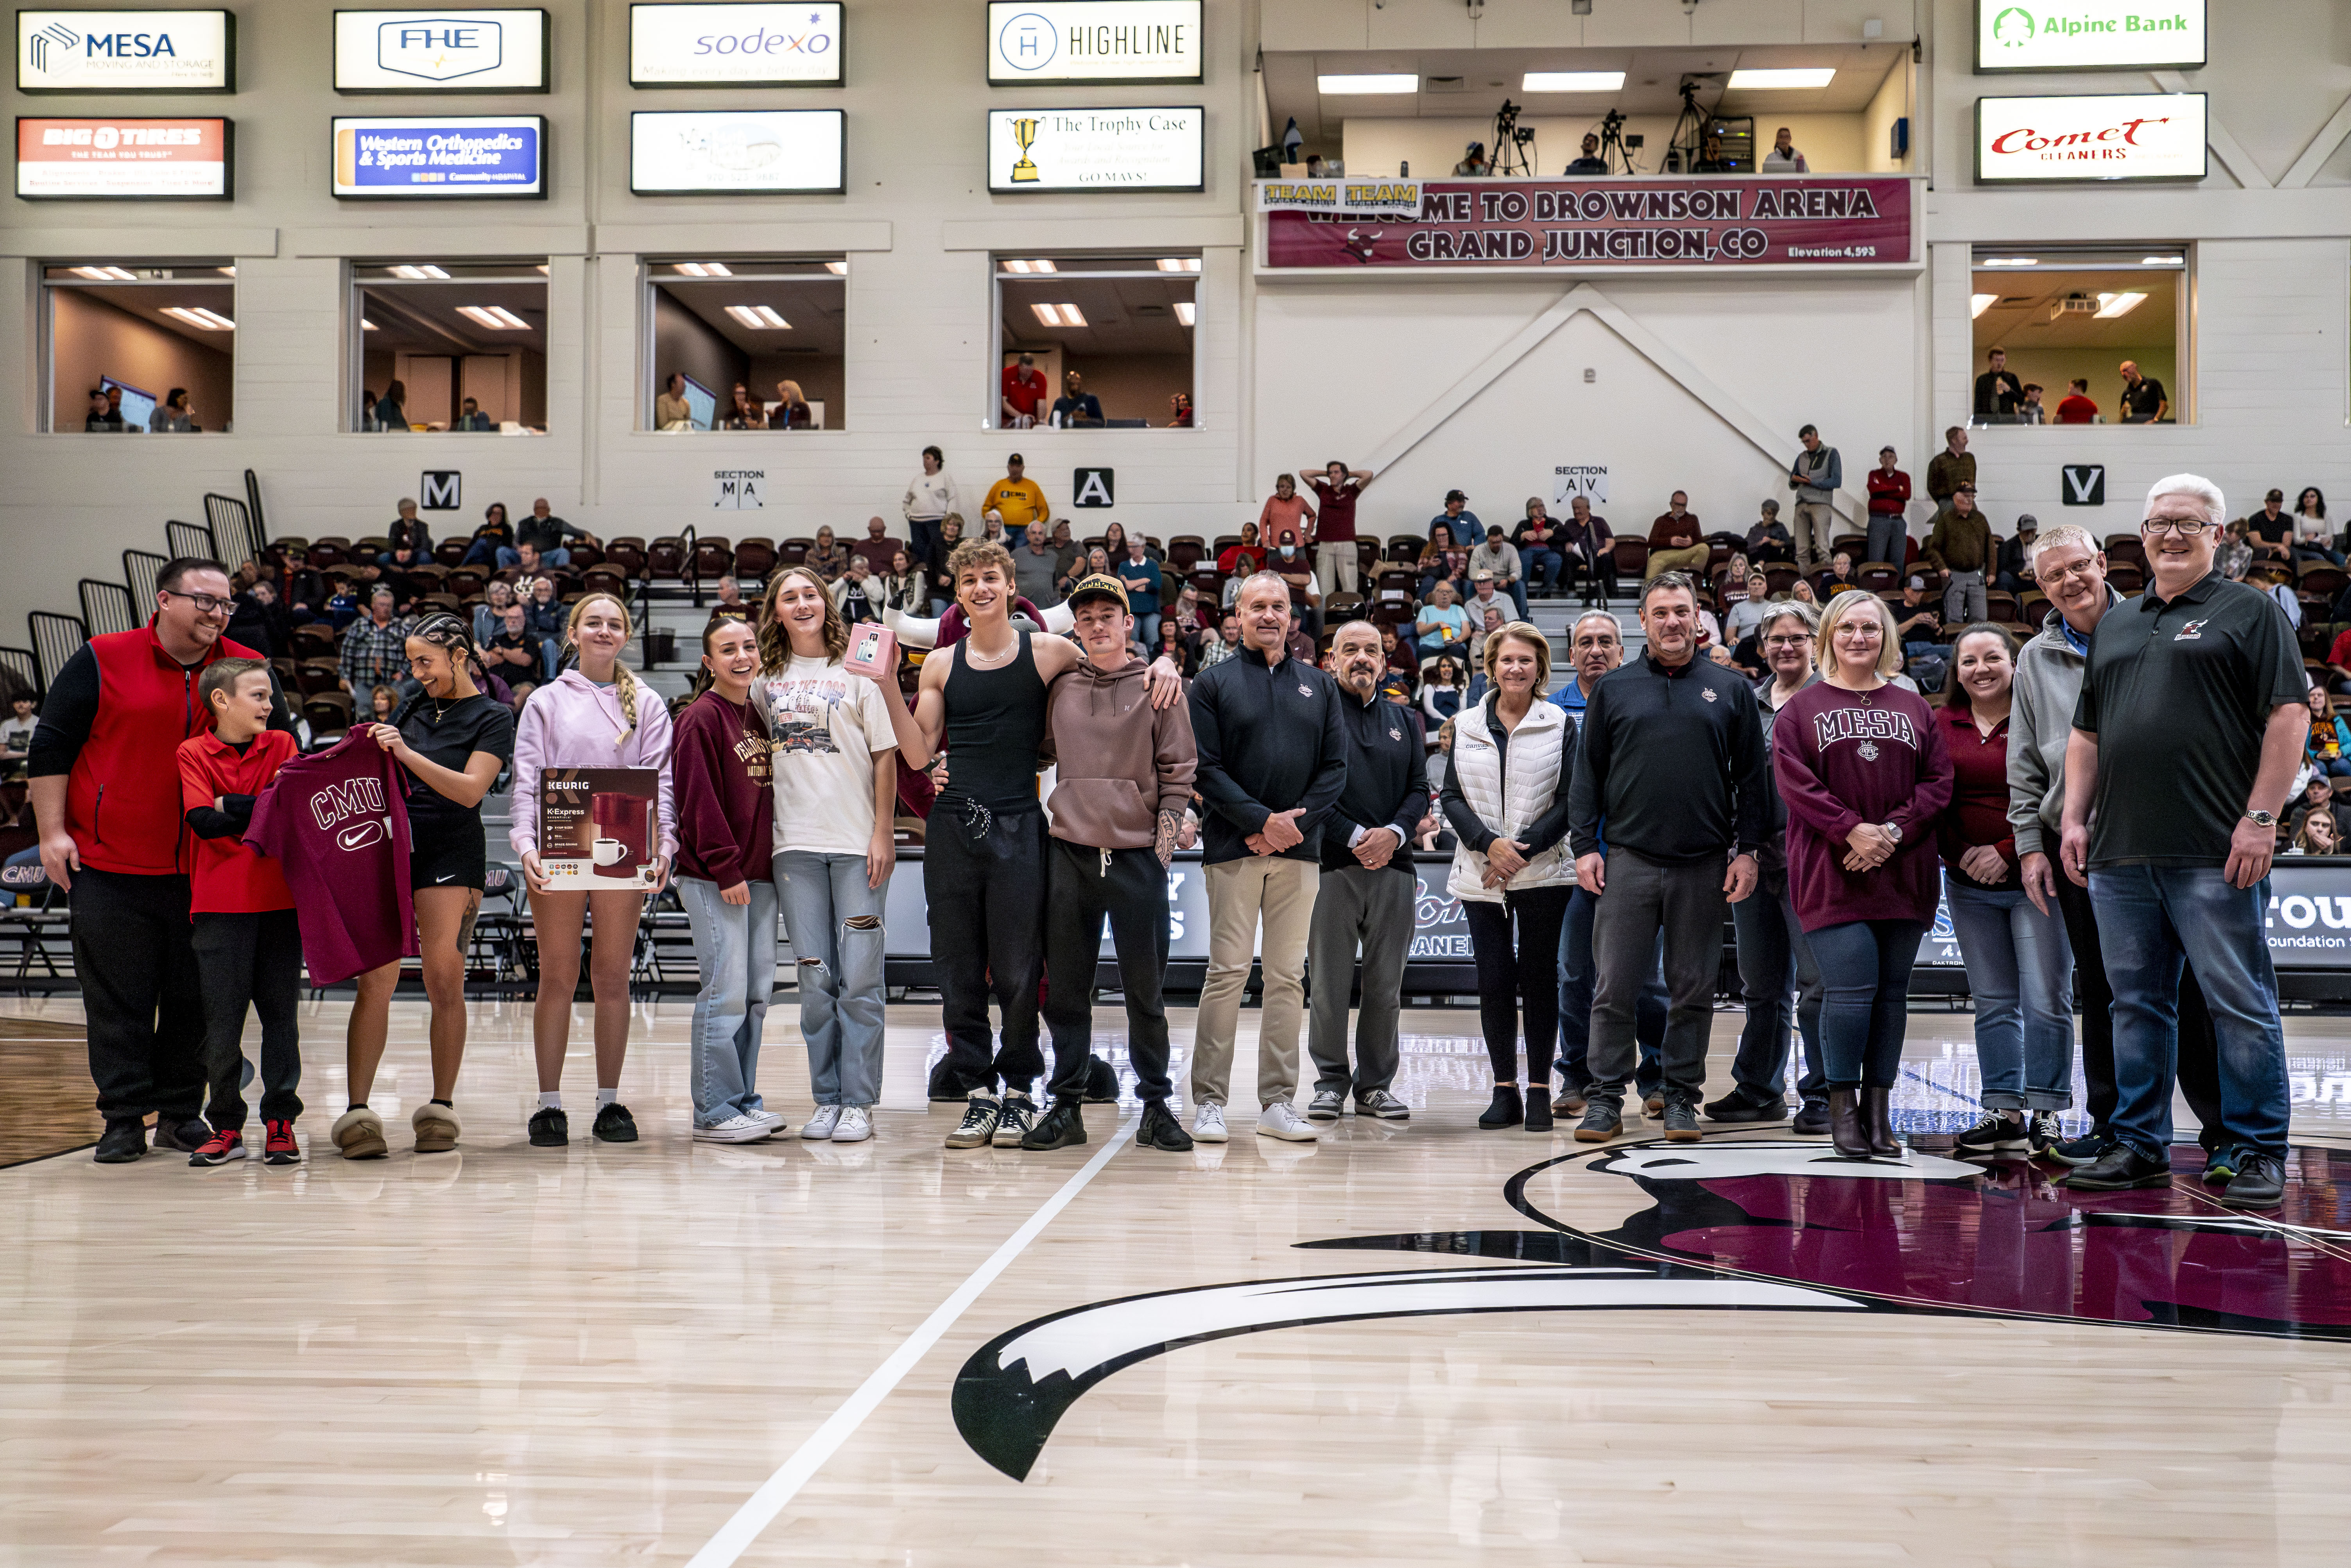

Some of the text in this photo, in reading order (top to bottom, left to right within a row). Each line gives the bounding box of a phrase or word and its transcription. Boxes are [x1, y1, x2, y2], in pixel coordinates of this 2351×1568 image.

[2044, 14, 2188, 37] Alpine Bank
[88, 34, 176, 57] MESA
[401, 29, 479, 49] FHE
[694, 27, 830, 55] sodexo
[1070, 25, 1184, 55] HIGHLINE
[86, 59, 214, 69] MOVING AND STORAGE
[642, 66, 686, 77] Making
[692, 67, 723, 77] every
[729, 65, 750, 77] day
[767, 65, 801, 75] better
[807, 65, 829, 76] day
[1054, 115, 1186, 135] The Trophy Case
[43, 128, 92, 145] BIG
[118, 128, 201, 145] TIRES
[360, 133, 523, 154] Western Orthopedics
[1991, 117, 2169, 154] Comet
[1064, 142, 1083, 152] Your
[1087, 142, 1113, 151] Local
[1116, 142, 1148, 151] Source
[2041, 148, 2126, 161] CLEANERS
[358, 149, 501, 170] & Sports Medicine
[1057, 154, 1171, 165] Awards and Recognition
[449, 171, 491, 182] Community
[1079, 172, 1147, 183] GO MAVS!
[1265, 185, 1417, 201] TEAM TEAM
[1480, 190, 1529, 223] TO
[1534, 189, 1743, 221] BROWNSON
[1750, 188, 1880, 219] ARENA
[1407, 229, 1534, 262] GRAND
[1788, 246, 1876, 258] Elevation 4,593
[714, 471, 764, 479] SECTION
[1555, 466, 1607, 475] SECTION
[423, 473, 460, 507] M
[723, 482, 755, 495] M A
[1076, 471, 1113, 505] A
[1566, 478, 1596, 491] A V
[2064, 468, 2101, 502] V
[1813, 708, 1917, 753] MESA
[747, 765, 767, 777] NATIONAL
[311, 778, 386, 830] CMU
[2, 866, 46, 883] CMU
[2265, 935, 2346, 948] oundation
